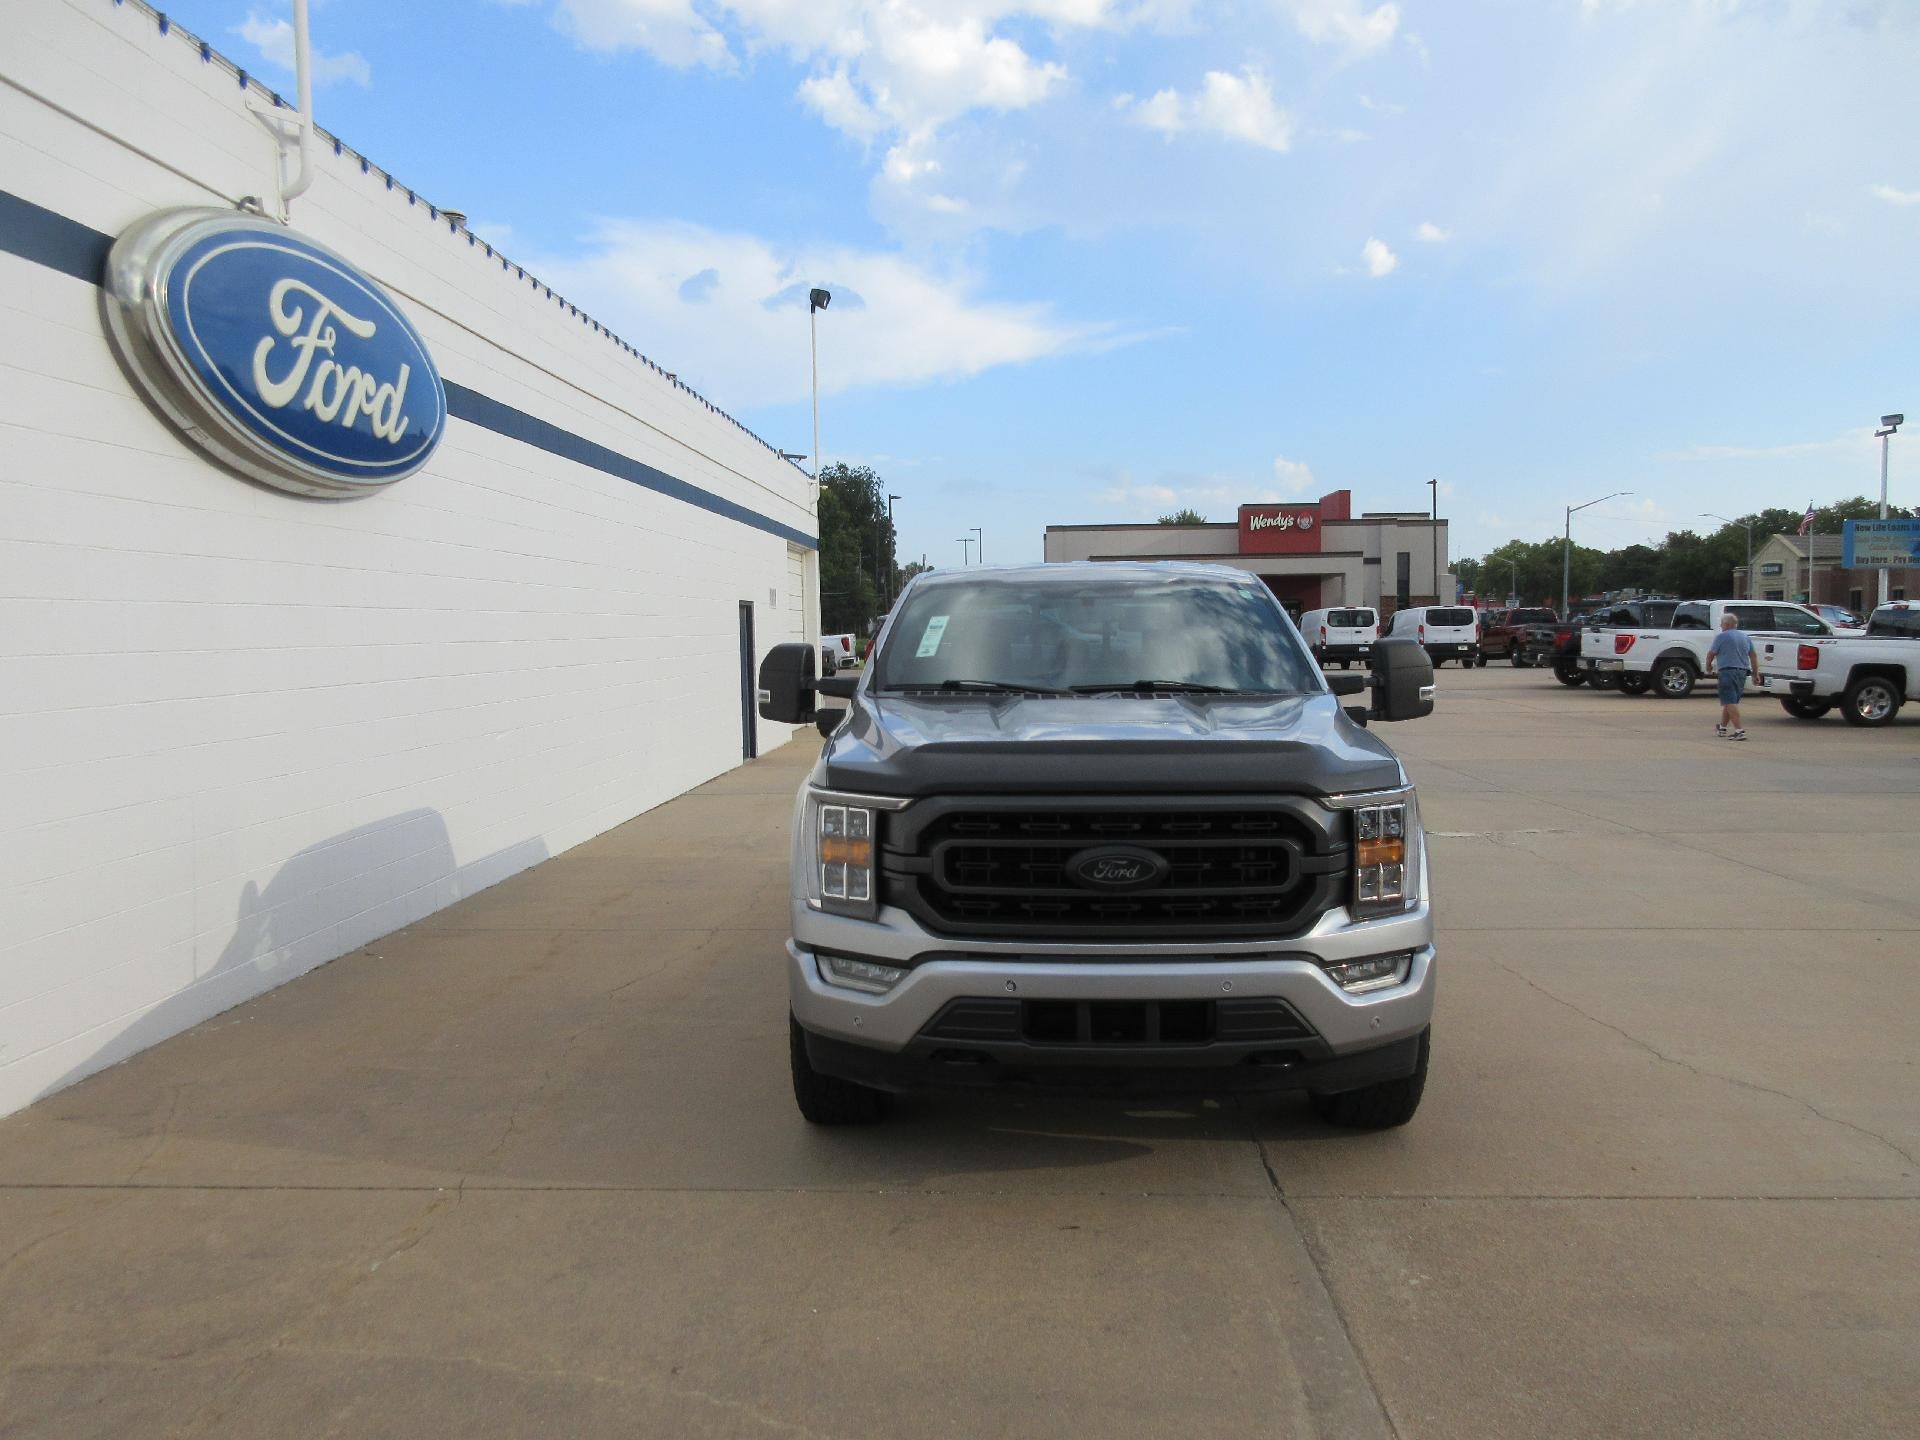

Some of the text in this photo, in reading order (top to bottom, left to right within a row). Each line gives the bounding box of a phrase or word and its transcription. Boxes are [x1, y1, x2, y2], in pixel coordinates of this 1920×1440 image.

[253, 278, 411, 444] Ford
[1250, 511, 1294, 531] Wendy's
[1093, 859, 1141, 879] Ford
